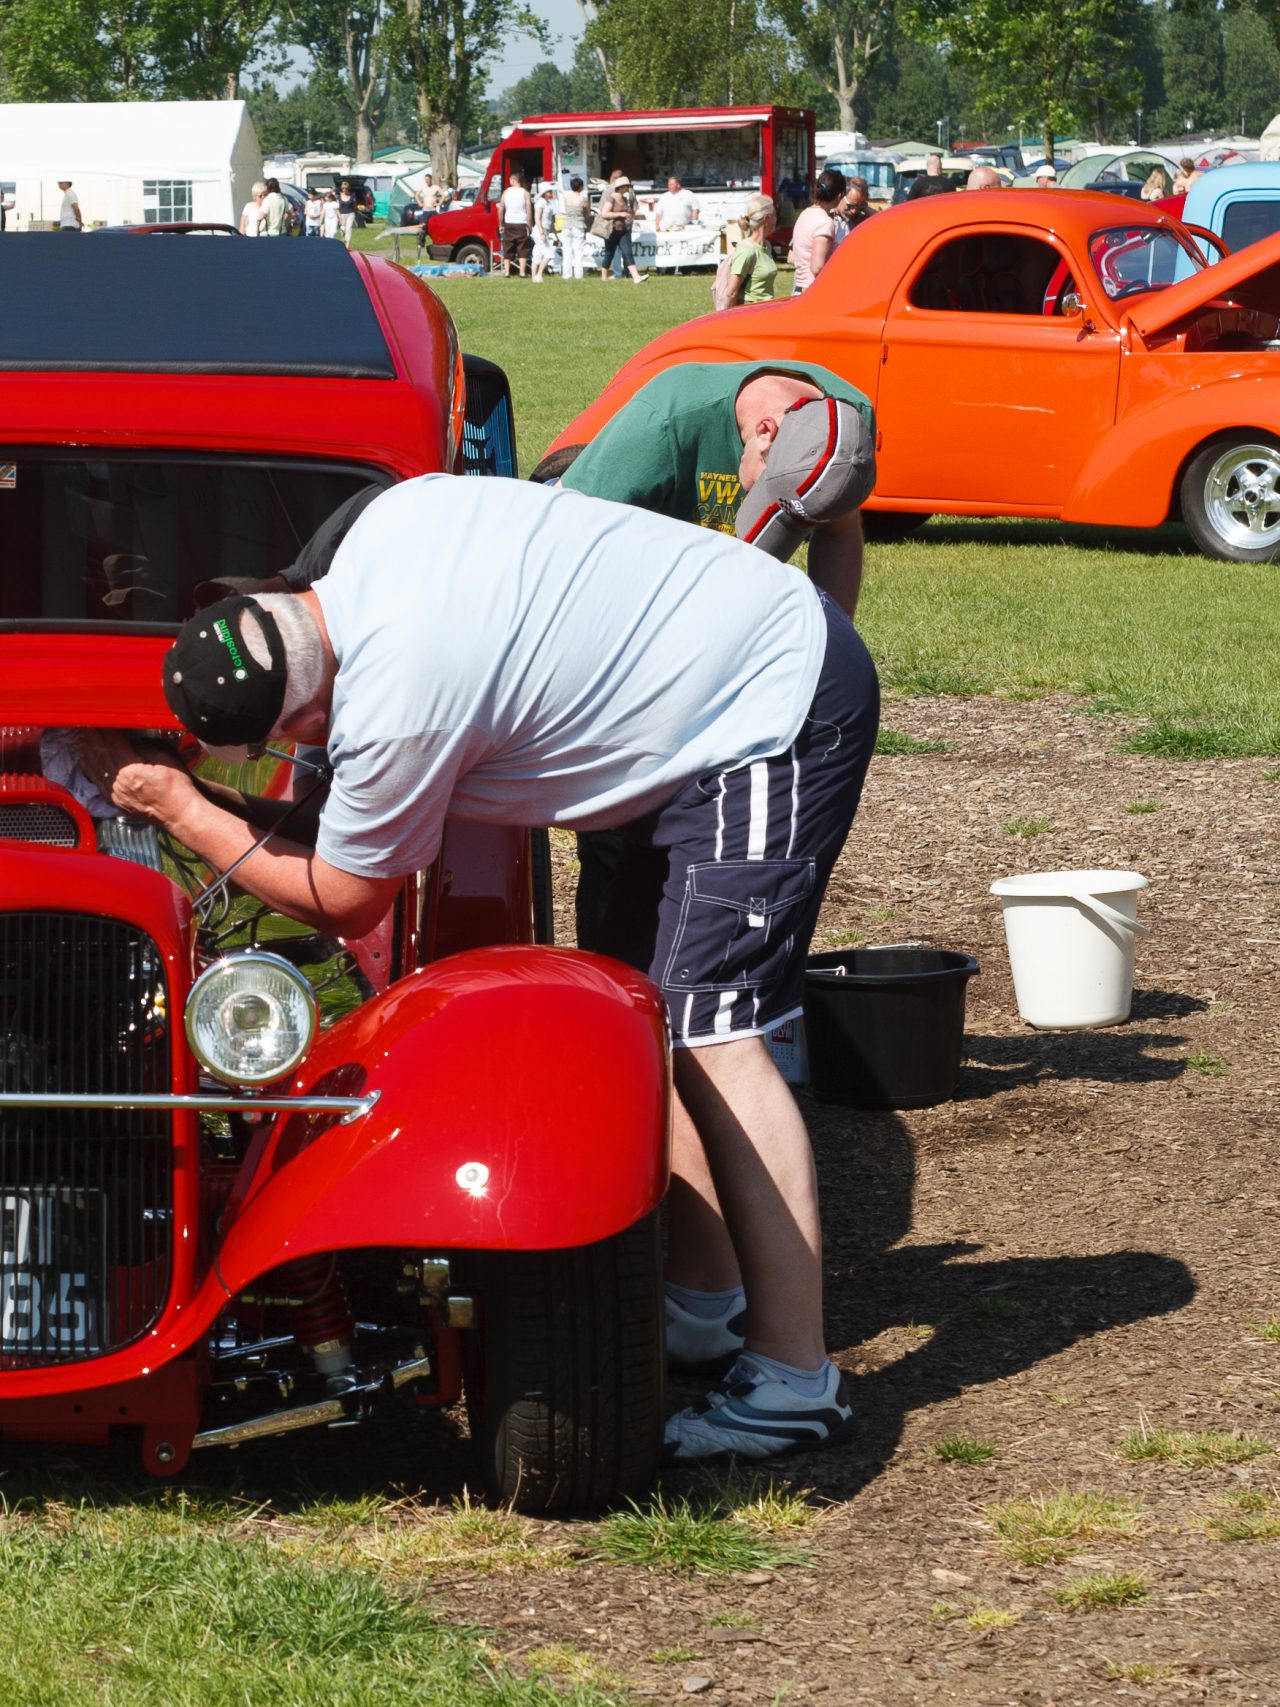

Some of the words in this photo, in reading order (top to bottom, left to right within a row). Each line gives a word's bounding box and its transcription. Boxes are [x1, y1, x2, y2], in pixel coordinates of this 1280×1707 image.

[632, 241, 672, 257] Truck
[680, 241, 715, 256] Parts
[701, 472, 737, 482] HAYNES
[699, 480, 740, 504] VW
